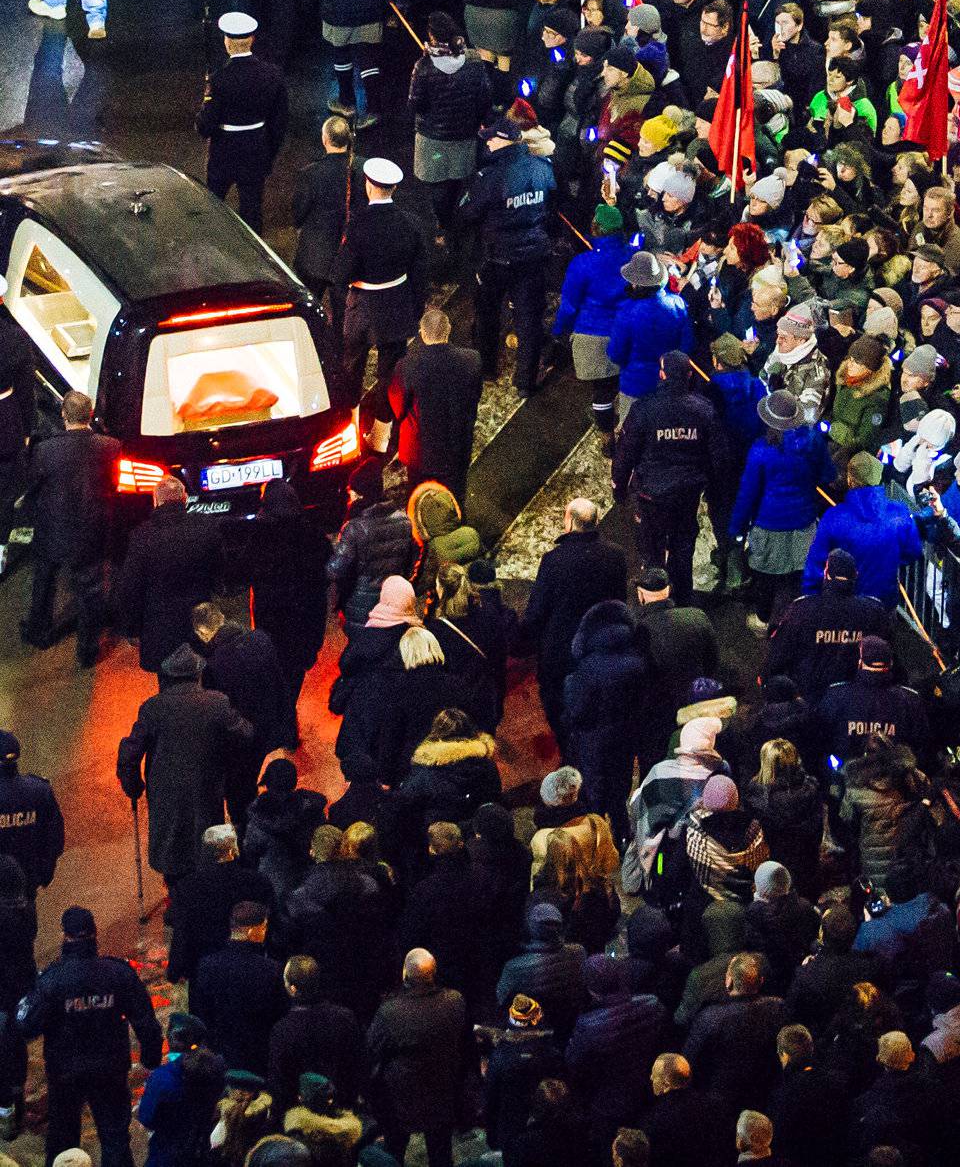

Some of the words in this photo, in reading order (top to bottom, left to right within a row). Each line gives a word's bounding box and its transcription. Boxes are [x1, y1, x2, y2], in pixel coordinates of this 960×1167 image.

[506, 190, 544, 209] POLICJA
[210, 468, 232, 485] GD
[239, 462, 280, 482] 199LL
[815, 630, 863, 643] POLICJA
[847, 720, 896, 736] POLICJA
[64, 994, 114, 1013] POLICJA
